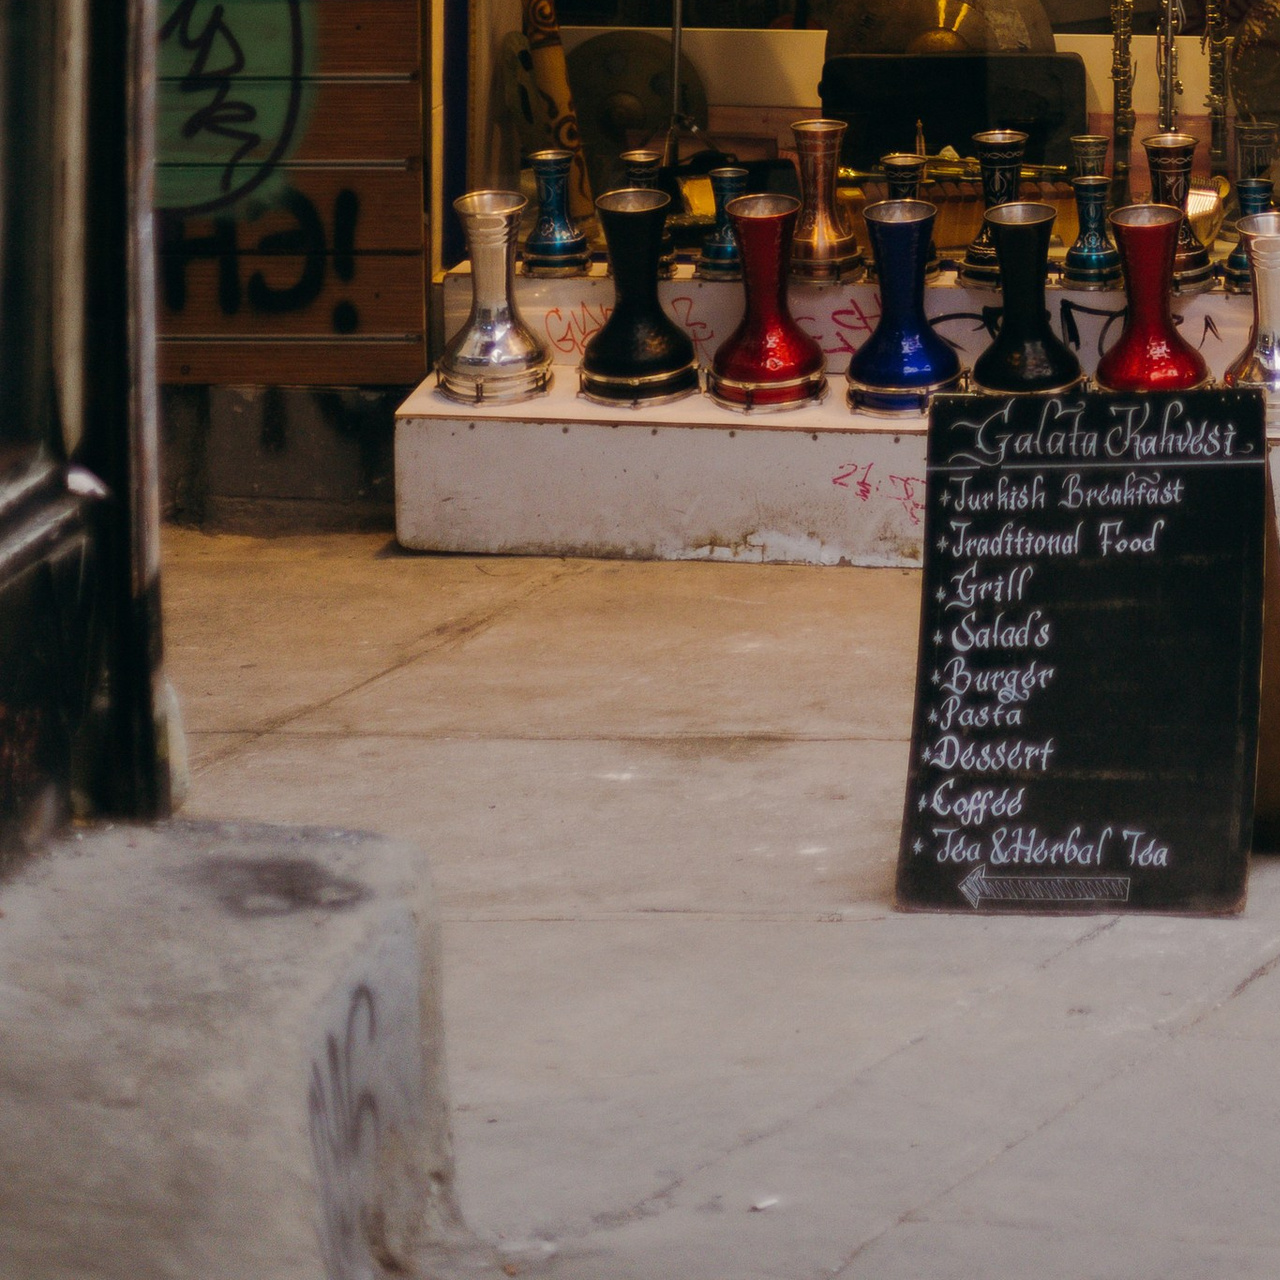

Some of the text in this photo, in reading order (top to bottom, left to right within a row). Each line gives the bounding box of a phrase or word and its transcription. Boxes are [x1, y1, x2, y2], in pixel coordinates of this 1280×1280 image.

[950, 398, 1254, 468] Galata Kahvesi
[951, 474, 1046, 511] Turkish
[1058, 471, 1186, 509] Breakfast
[952, 520, 1166, 557] Traditional Food
[944, 561, 1034, 611] Grill
[939, 656, 1055, 704] Burger
[940, 695, 1022, 727] Pasta
[931, 737, 1055, 772] Dessert
[931, 779, 1026, 826] Coffee
[932, 827, 981, 864] Tea
[1122, 829, 1169, 867] Tea
